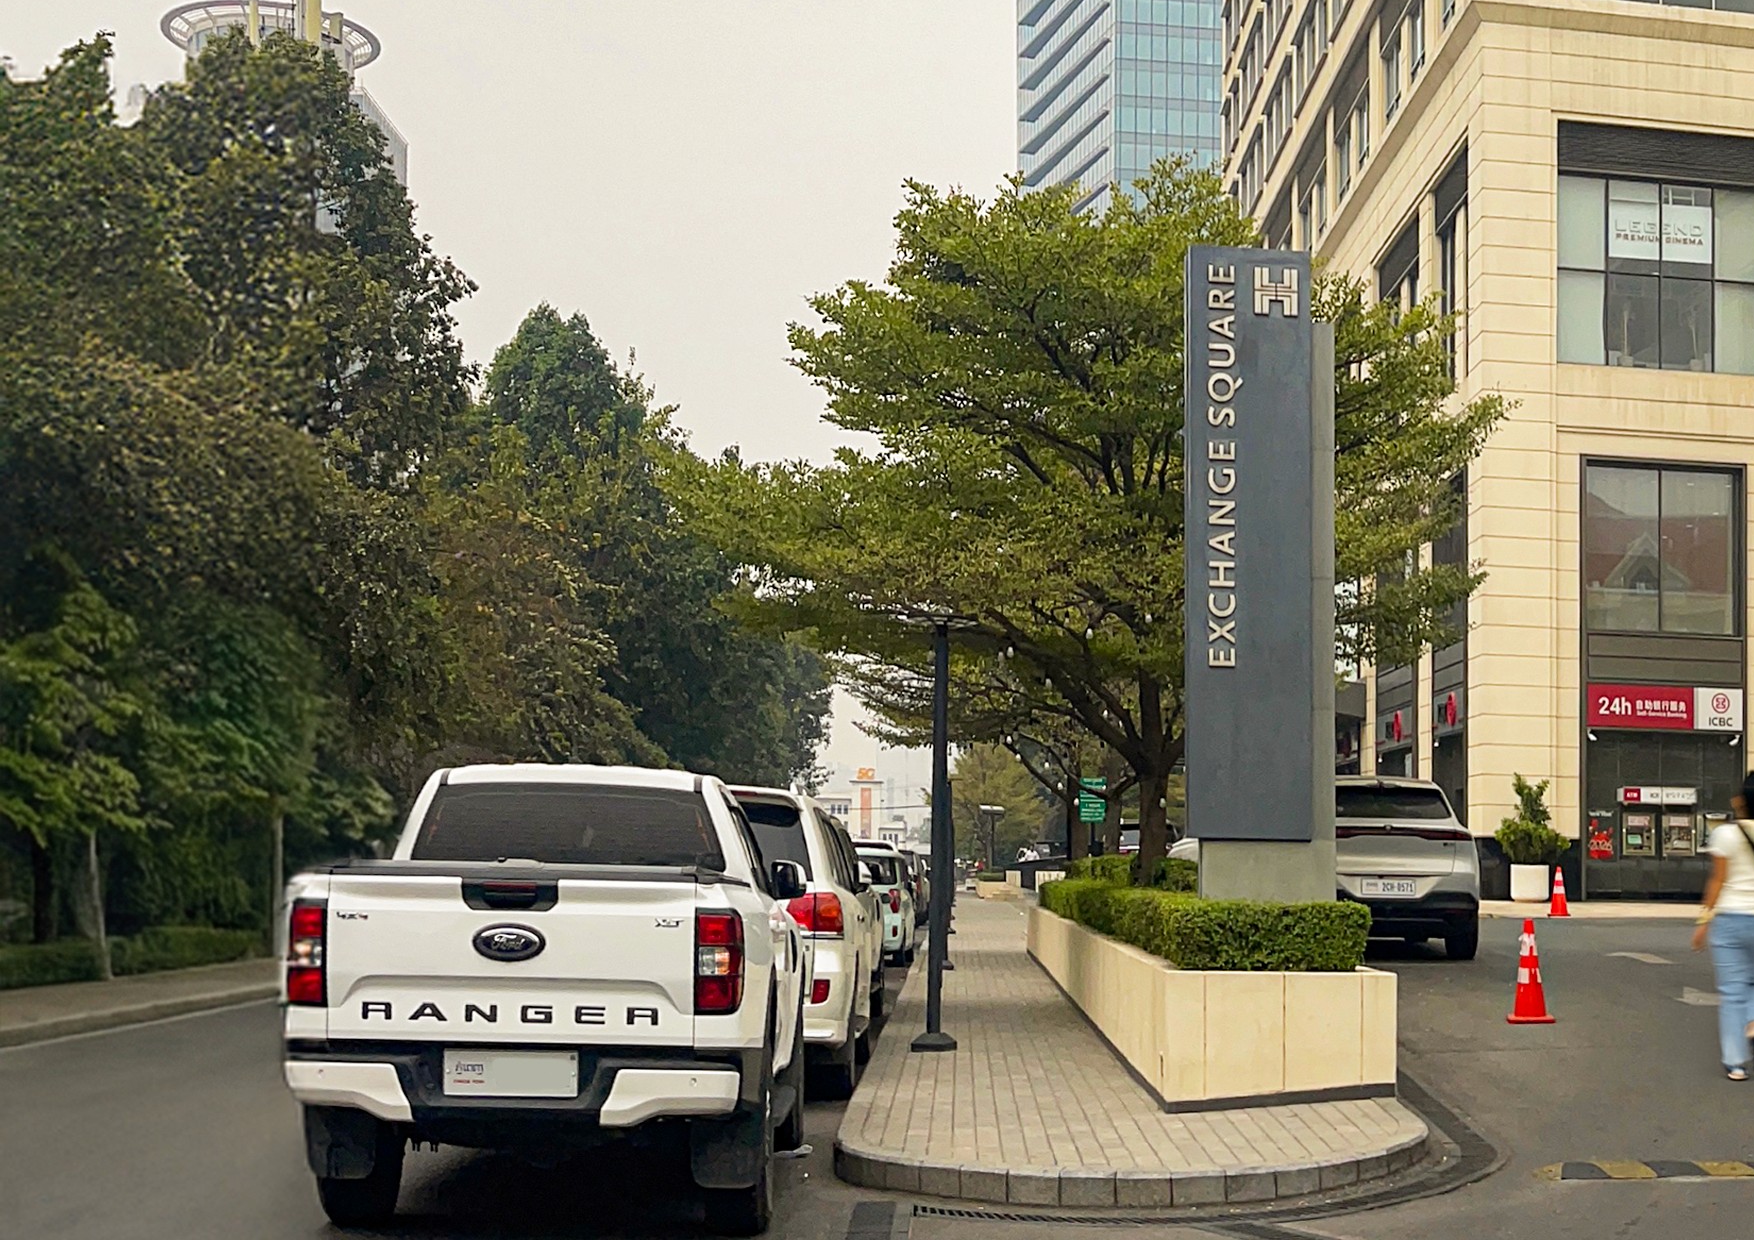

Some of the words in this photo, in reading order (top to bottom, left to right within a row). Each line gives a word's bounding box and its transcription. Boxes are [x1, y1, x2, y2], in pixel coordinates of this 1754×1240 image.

[1615, 220, 1703, 237] LEGEND
[1615, 233, 1660, 243] PREMIUM
[1665, 236, 1704, 246] CINEMA
[1208, 264, 1243, 427] SQUARE
[1208, 441, 1236, 668] EXCHANGE
[1598, 696, 1632, 715] 24h
[1708, 717, 1733, 727] ICBC
[857, 767, 875, 779] 5G
[490, 933, 526, 951] Ford
[361, 1001, 659, 1026] RANGER
